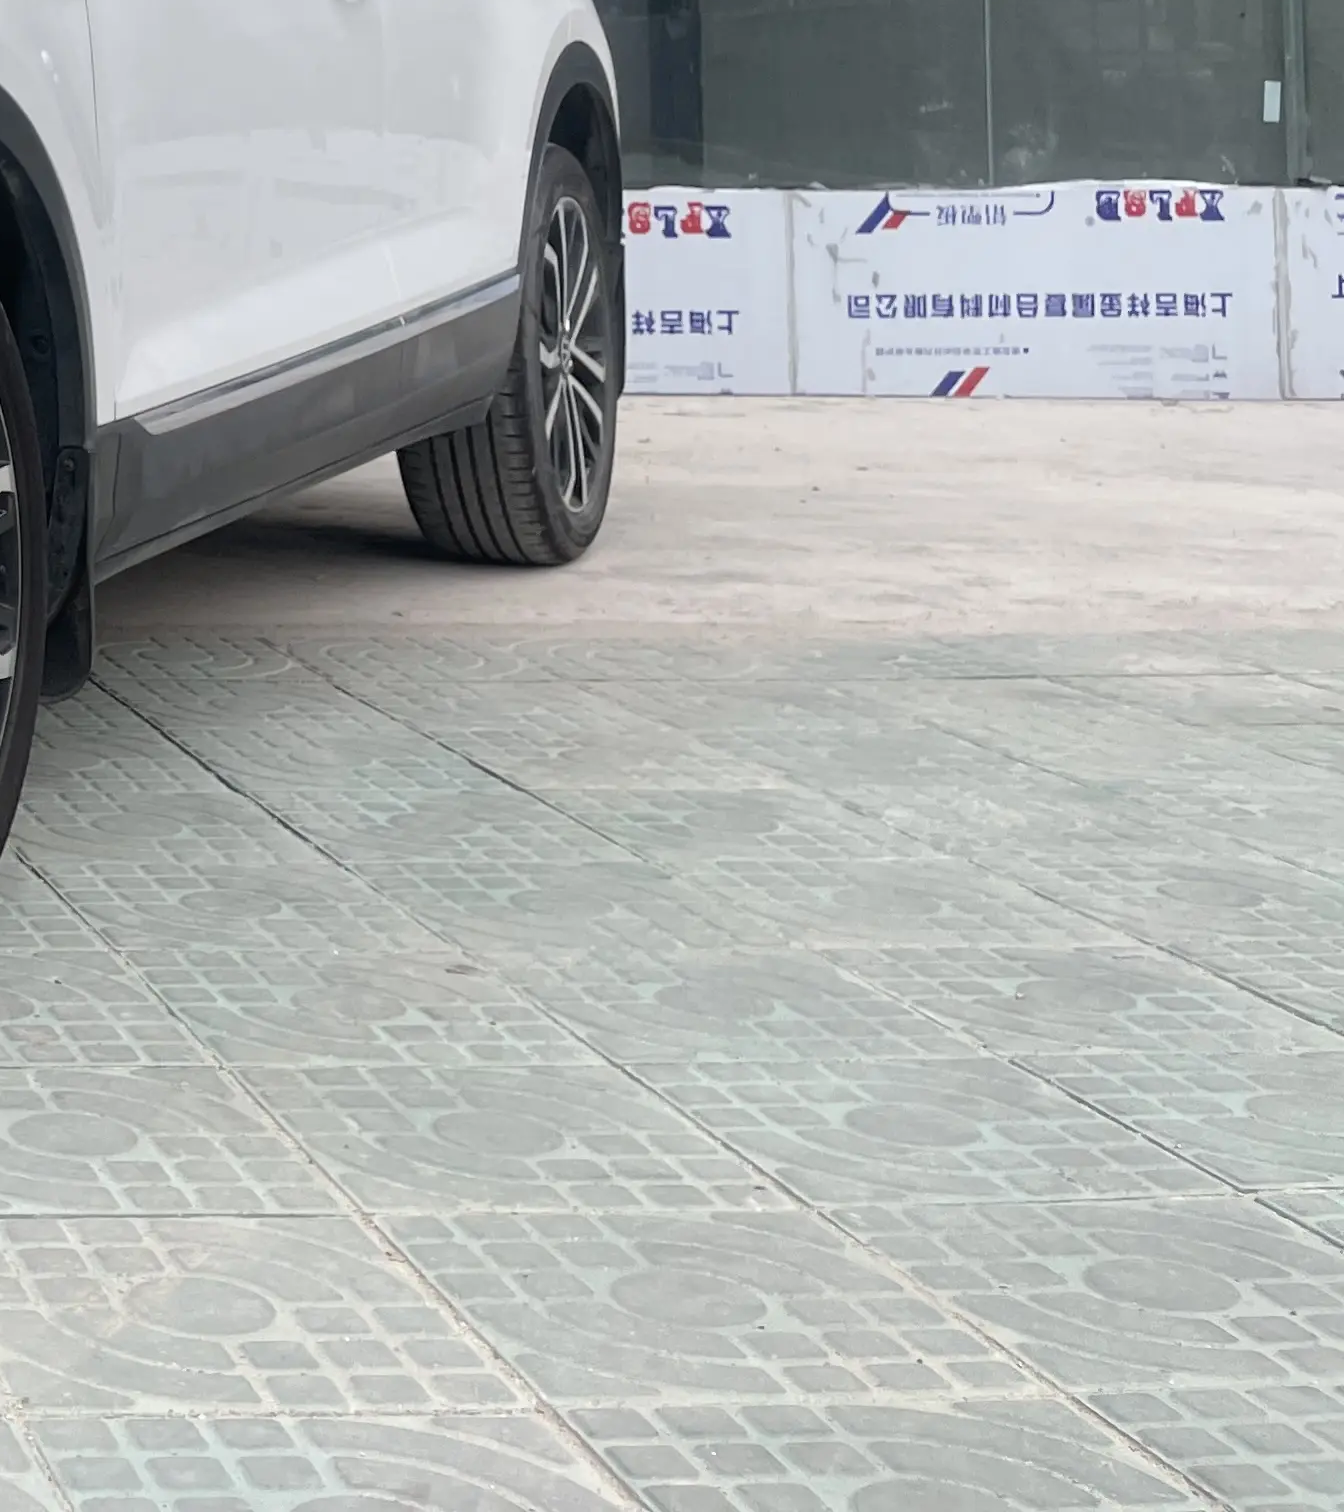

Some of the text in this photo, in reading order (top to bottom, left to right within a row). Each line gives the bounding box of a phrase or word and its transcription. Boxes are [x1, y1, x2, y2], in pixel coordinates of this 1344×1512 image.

[620, 201, 732, 239] XPLS
[847, 292, 1233, 319] 上海吉祥金属复合材料有限公司
[631, 309, 740, 336] 上海吉祥
